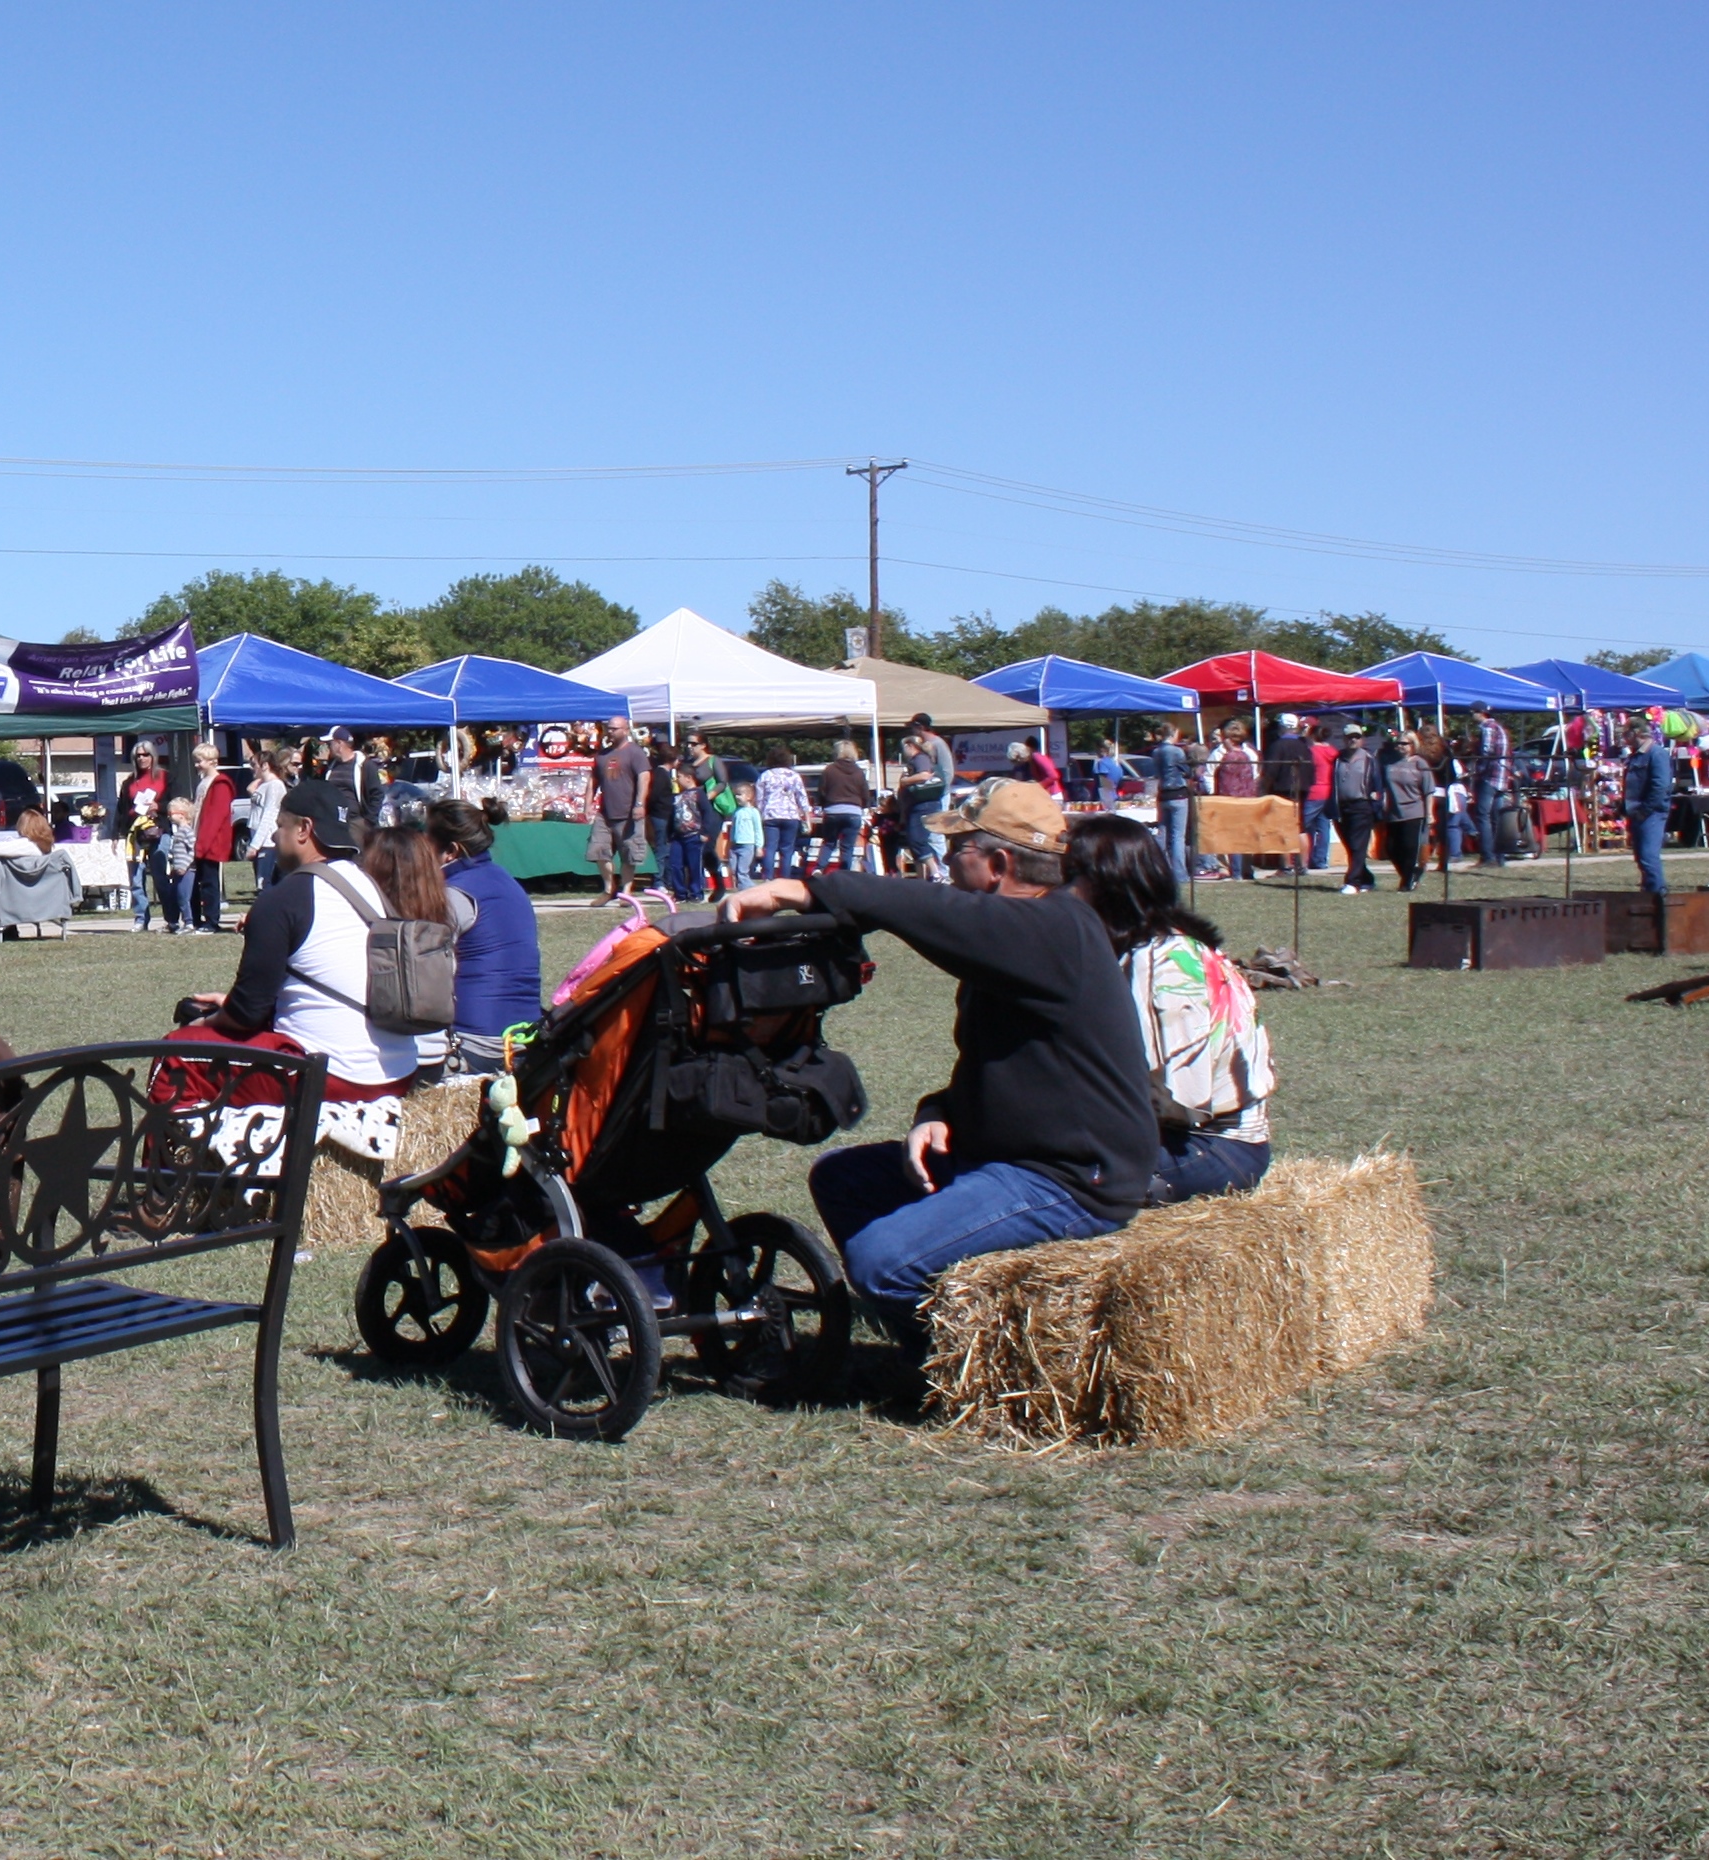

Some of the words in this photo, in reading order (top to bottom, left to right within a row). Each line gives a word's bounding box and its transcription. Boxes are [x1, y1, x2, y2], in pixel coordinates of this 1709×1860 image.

[58, 662, 108, 679] Relay
[113, 655, 146, 671] For
[148, 643, 187, 663] Life
[50, 687, 74, 696] about
[101, 696, 119, 705] that
[141, 694, 154, 702] up
[154, 691, 168, 700] the
